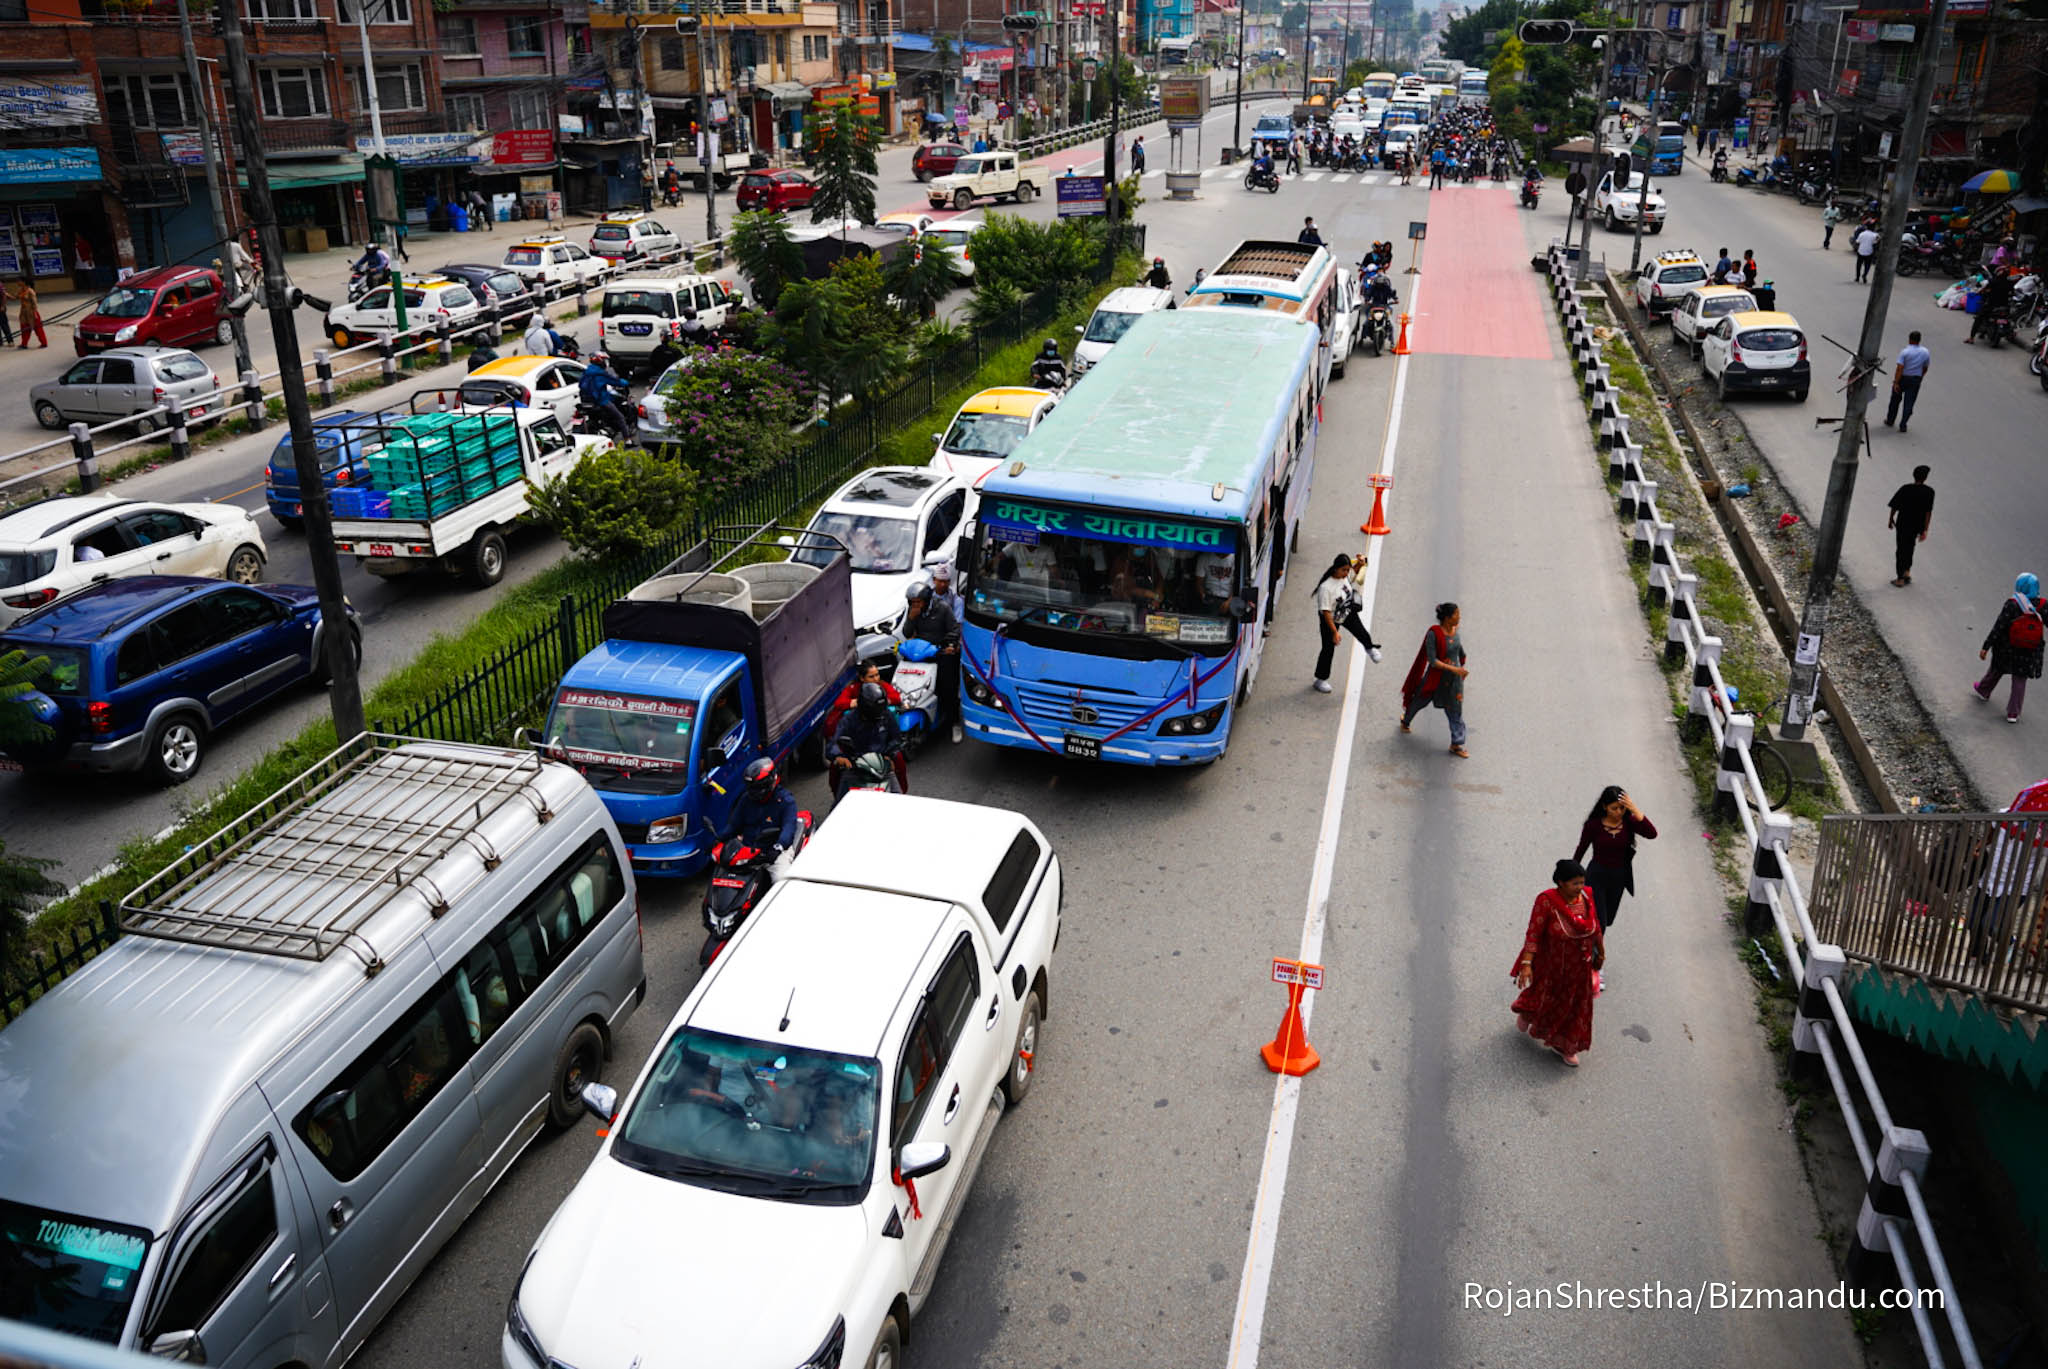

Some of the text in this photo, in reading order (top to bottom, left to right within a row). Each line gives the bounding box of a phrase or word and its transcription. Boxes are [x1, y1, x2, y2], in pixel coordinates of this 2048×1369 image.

[18, 86, 52, 99] Beauty
[0, 104, 34, 115] raining
[6, 156, 92, 172] Medical Store
[996, 501, 1224, 546] मयूर यातायात
[37, 1220, 100, 1249] TOURIST
